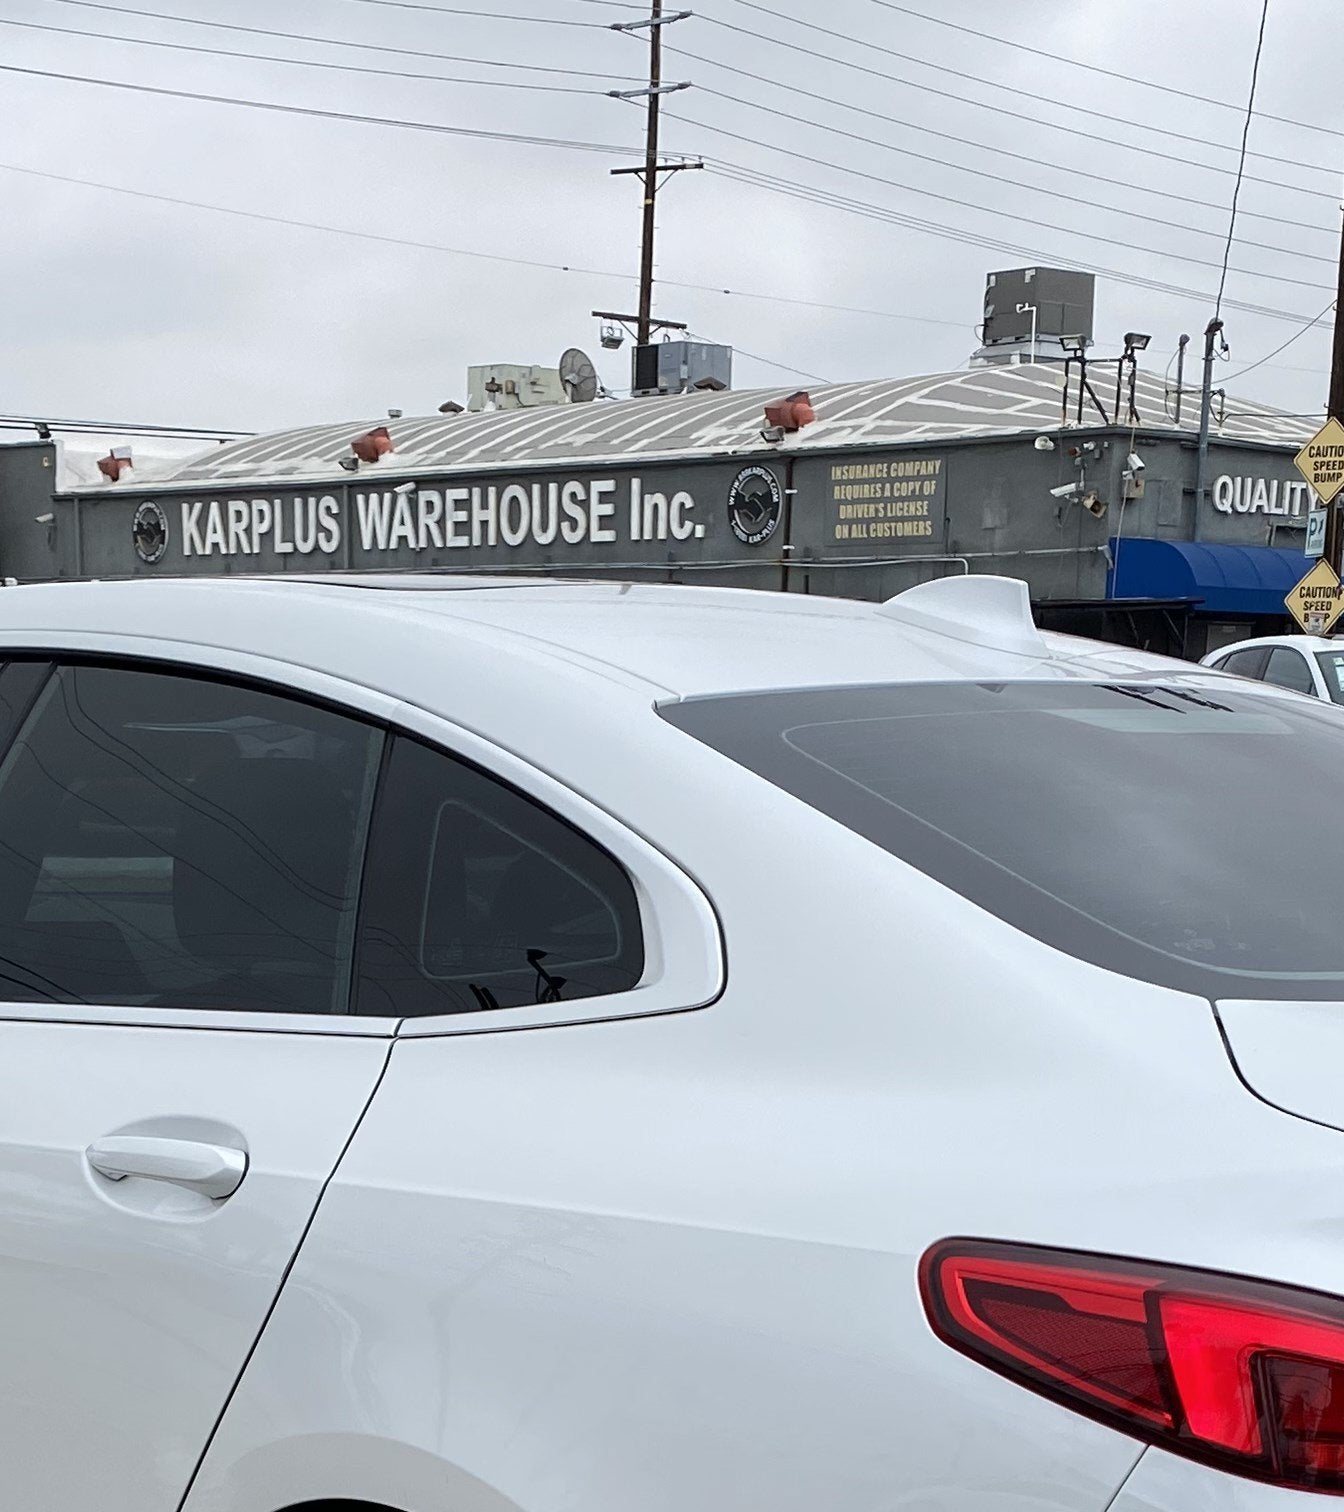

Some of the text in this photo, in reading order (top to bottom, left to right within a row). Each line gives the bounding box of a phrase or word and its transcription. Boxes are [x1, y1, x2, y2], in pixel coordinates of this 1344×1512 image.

[831, 460, 941, 480] INSURANCE COMPANY
[1313, 460, 1344, 471] SPEED
[1313, 472, 1343, 483] BUMP
[834, 480, 936, 500] REQUIRES A COPY OF
[1212, 475, 1319, 515] QUALITY
[181, 495, 341, 556] KARPLUS
[356, 479, 616, 551] WAREHOUSE
[630, 477, 705, 541] Inc.
[839, 501, 929, 519] DRIVER'S LICENSE
[835, 521, 932, 539] ON ALL CUSTOMERS
[1299, 586, 1340, 599] CAUTION
[1303, 601, 1332, 611] SPEED
[1303, 612, 1331, 623] BP
